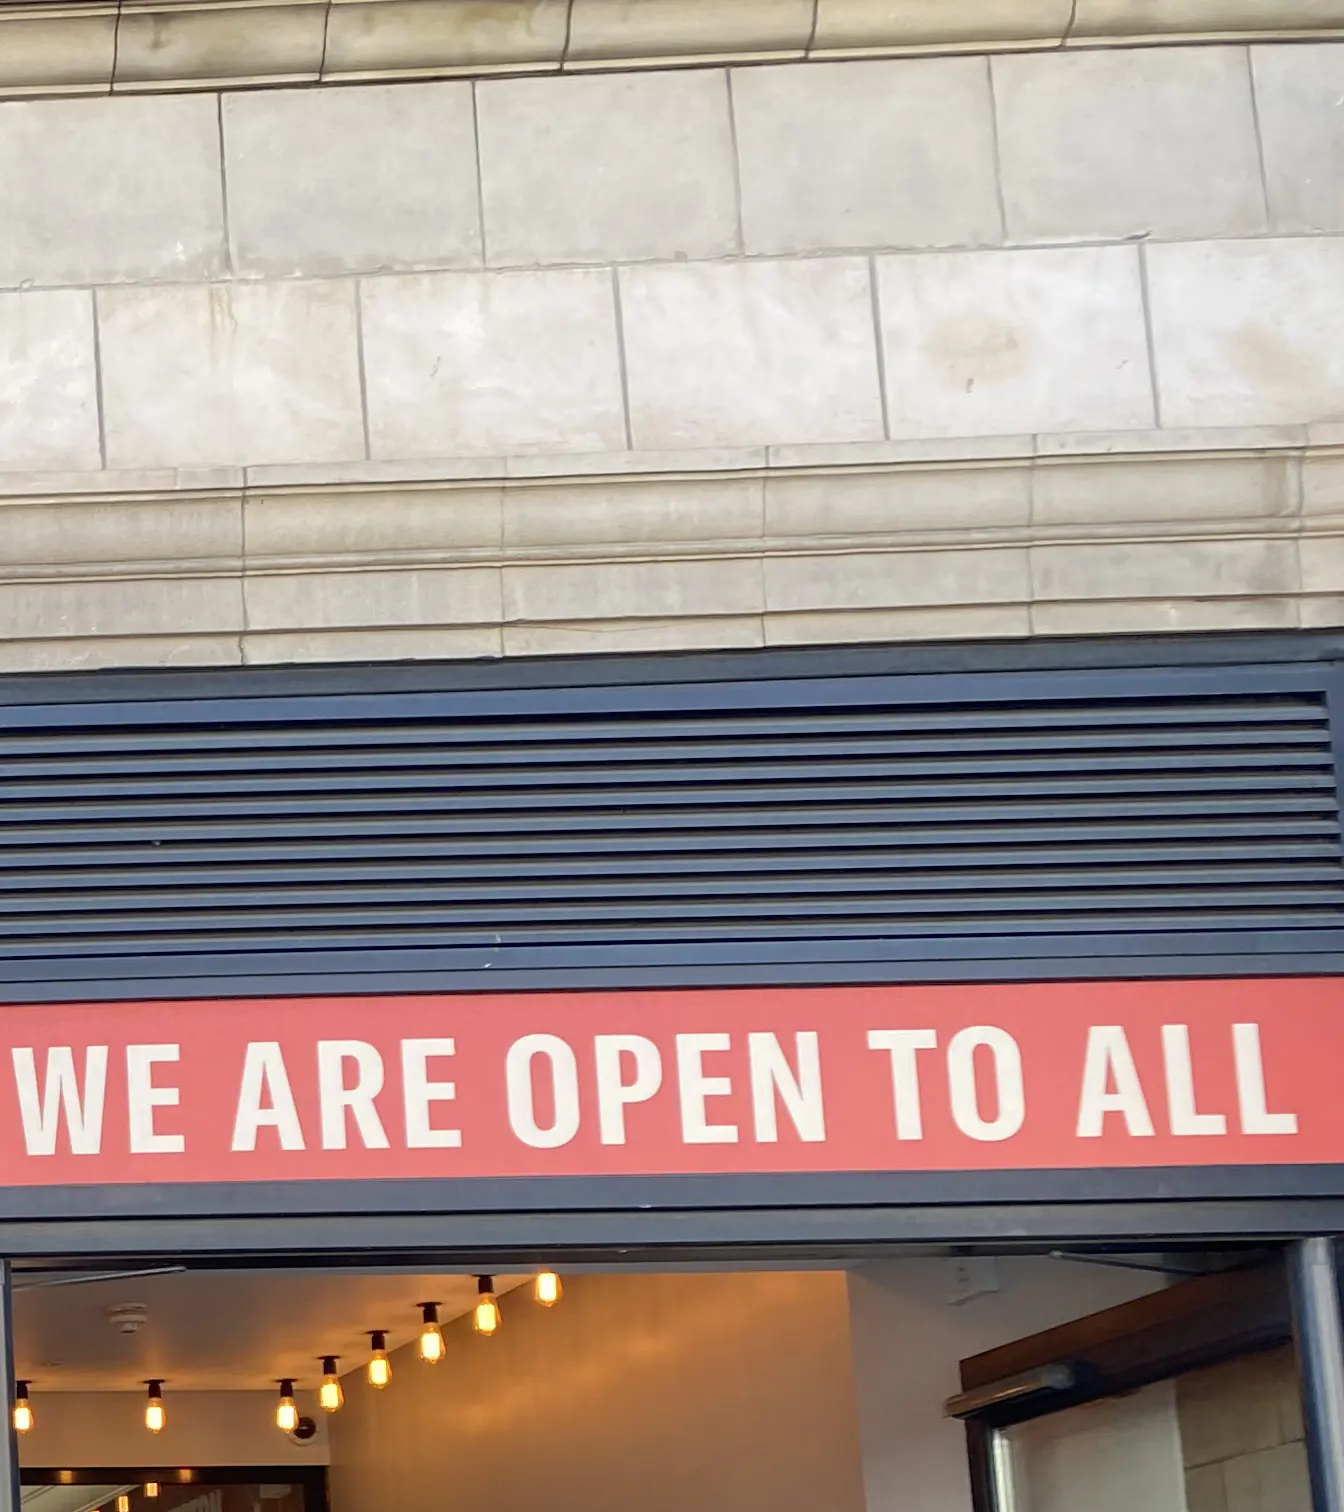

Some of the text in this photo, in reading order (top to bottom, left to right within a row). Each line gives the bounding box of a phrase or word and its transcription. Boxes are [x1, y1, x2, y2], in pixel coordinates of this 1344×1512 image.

[11, 1022, 1298, 1156] WE ARE OPEN TO ALL
